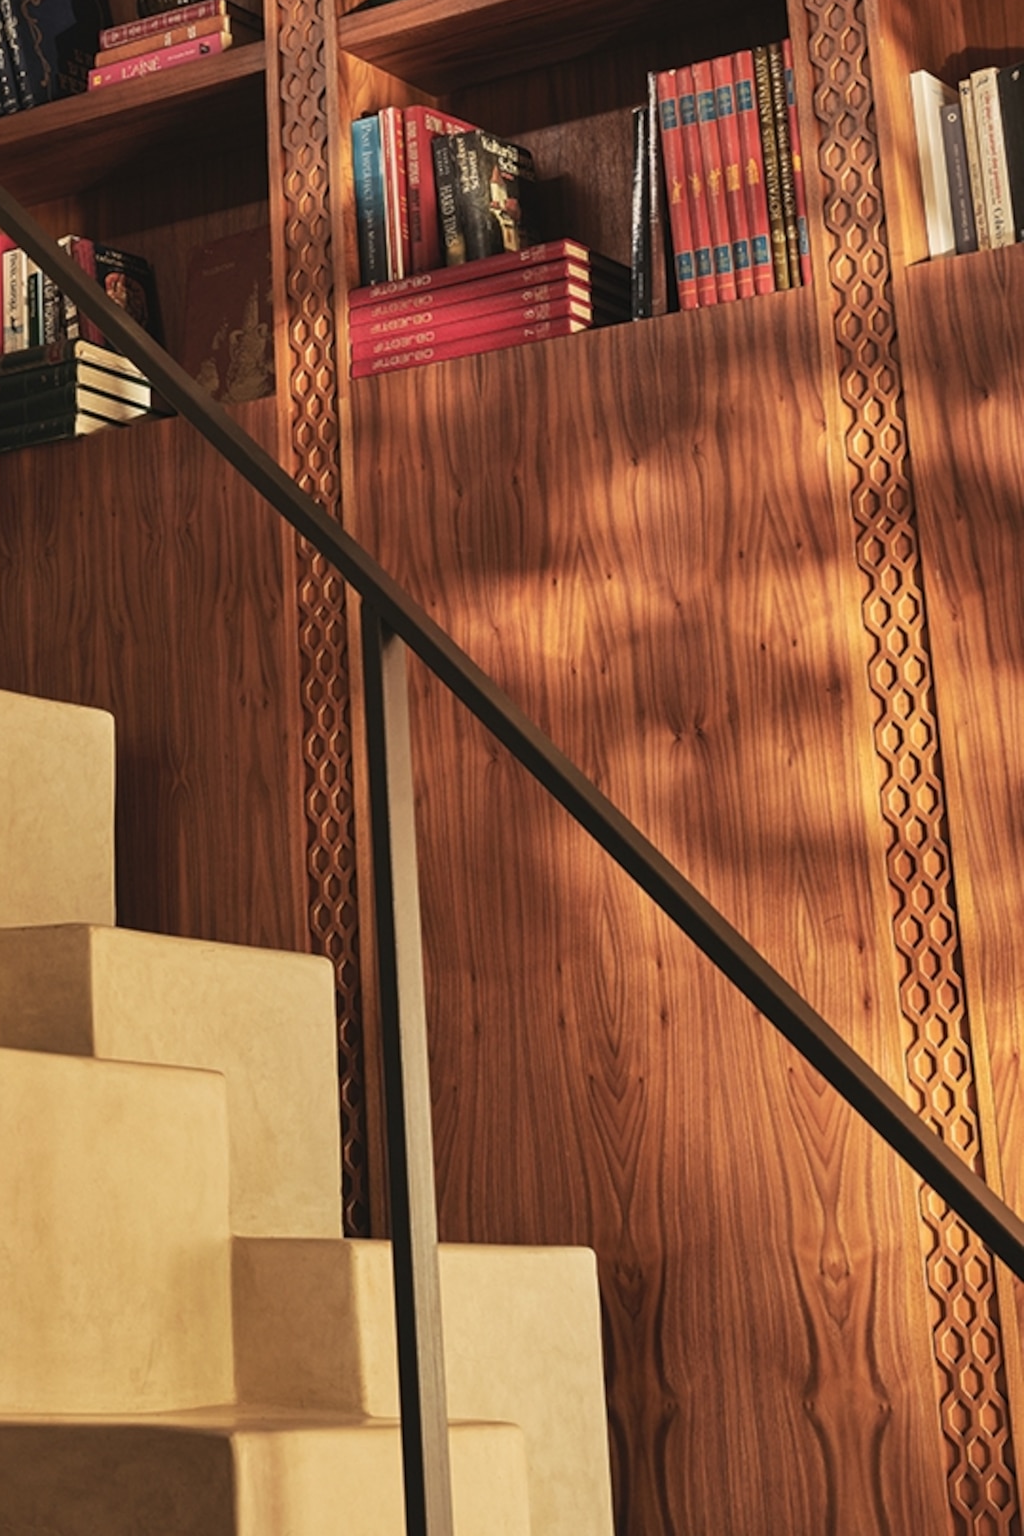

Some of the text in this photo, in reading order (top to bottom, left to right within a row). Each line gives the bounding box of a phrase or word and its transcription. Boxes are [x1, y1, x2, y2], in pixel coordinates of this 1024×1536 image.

[770, 52, 786, 118] ANIMAUX
[755, 57, 782, 219] ROYAUME DES ANIMAUX
[439, 185, 458, 247] HARD TIMES
[780, 154, 795, 216] ROYAUME
[370, 312, 433, 335] OBJECTIF
[373, 331, 436, 354] OBJECTIF
[372, 348, 435, 371] OBJECTIF
